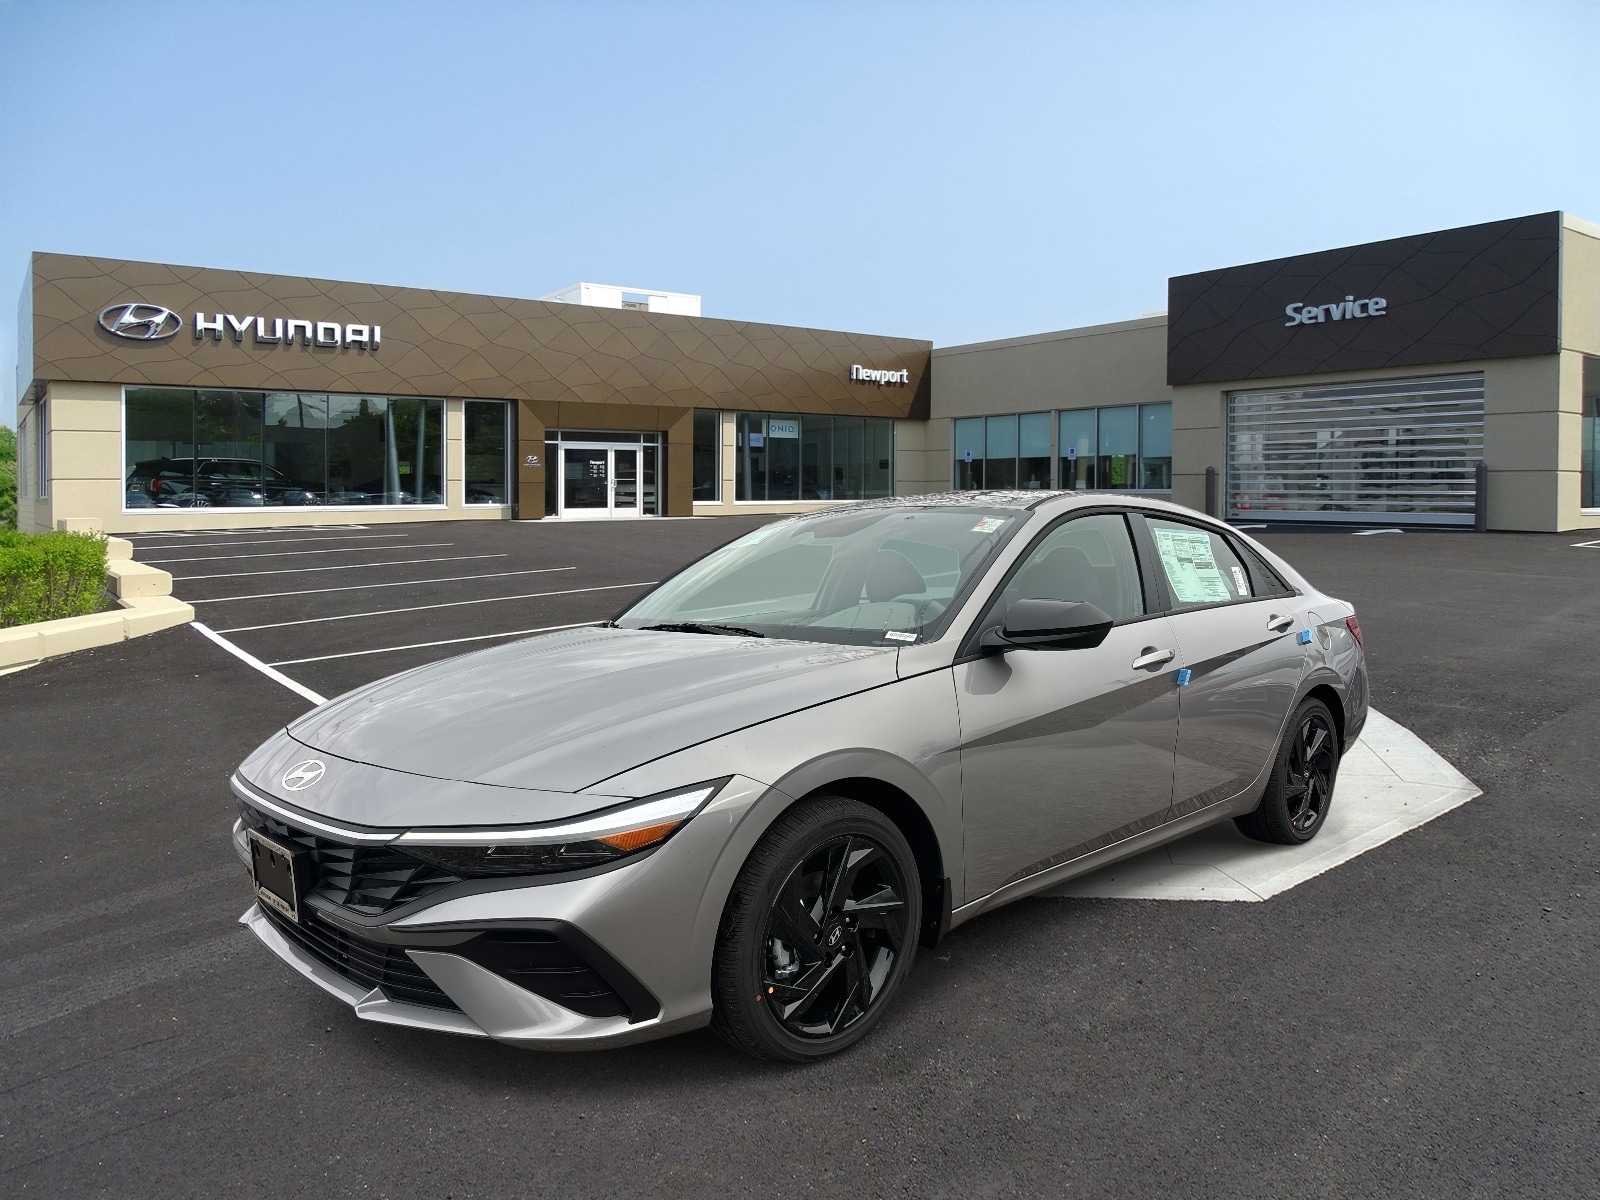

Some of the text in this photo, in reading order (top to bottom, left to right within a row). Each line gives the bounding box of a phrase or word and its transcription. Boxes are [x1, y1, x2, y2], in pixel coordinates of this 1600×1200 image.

[1285, 295, 1387, 327] Service
[195, 312, 381, 350] HYUNDAI
[850, 364, 909, 385] Newport
[770, 425, 795, 433] ONIQ
